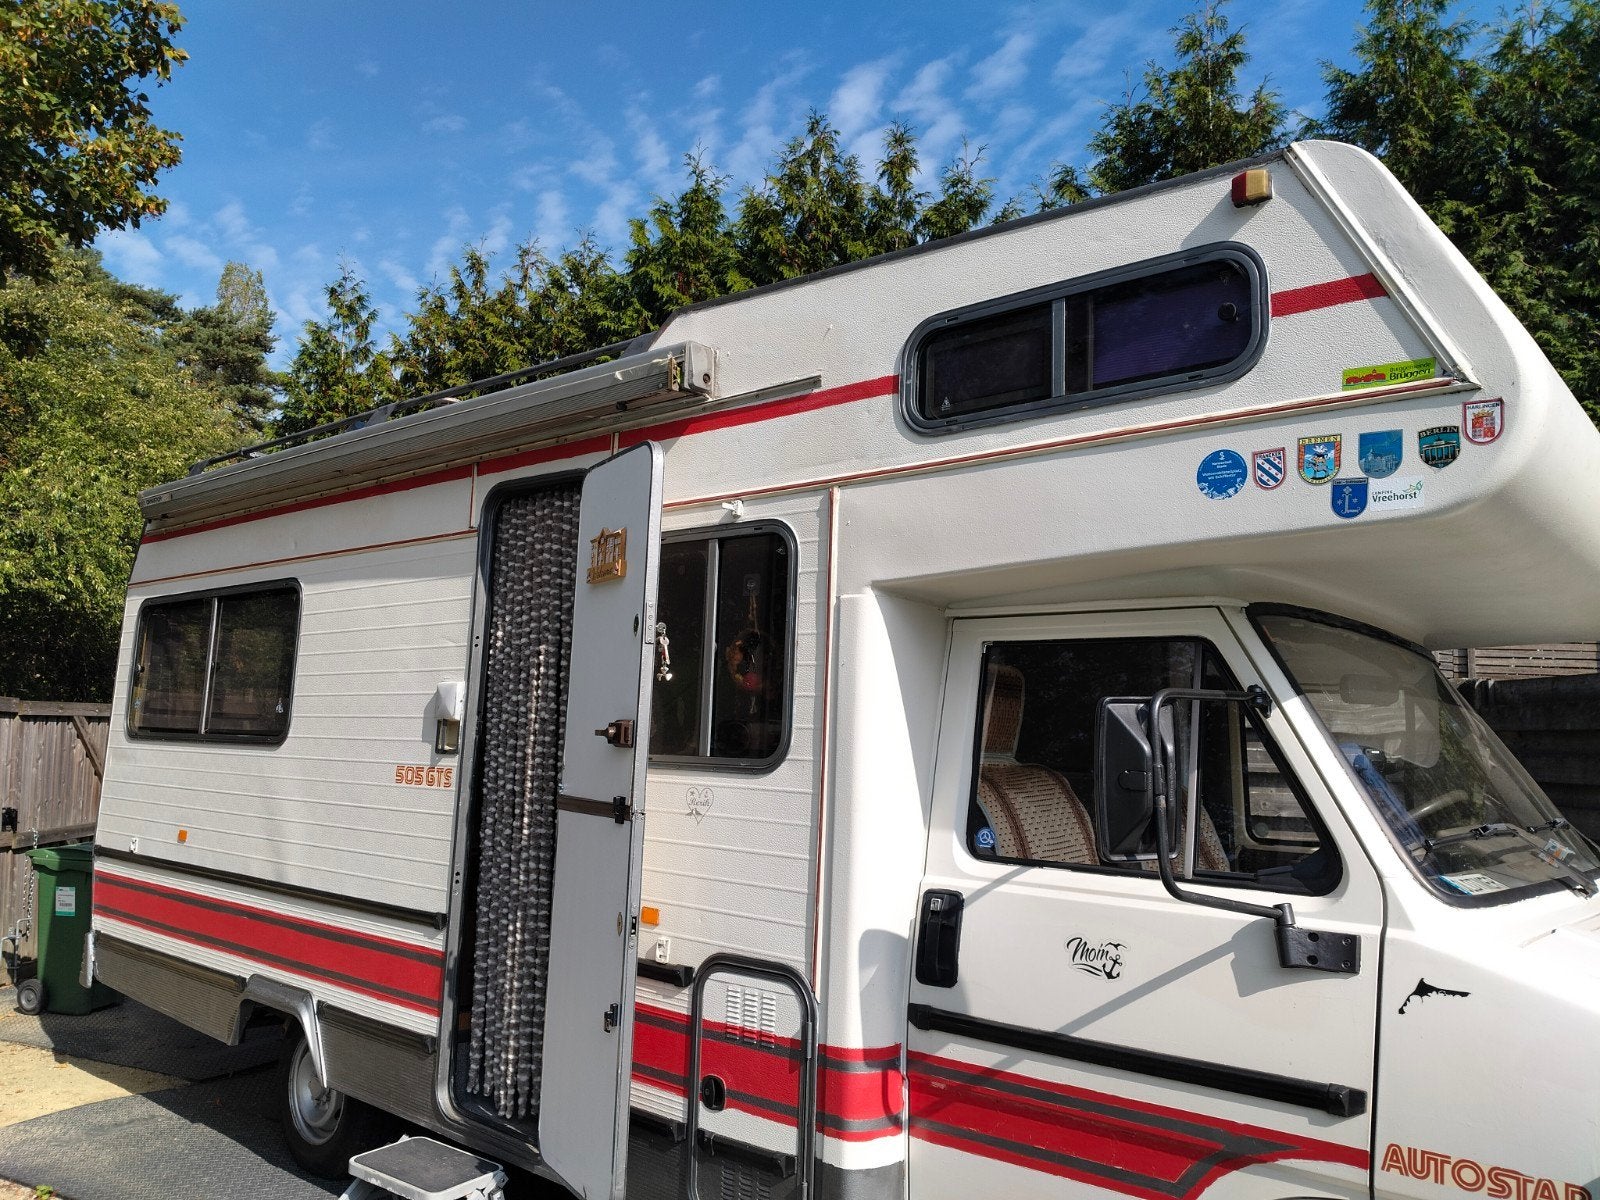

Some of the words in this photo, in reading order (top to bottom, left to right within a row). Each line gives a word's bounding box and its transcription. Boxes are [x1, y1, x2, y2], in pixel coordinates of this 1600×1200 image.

[1390, 367, 1431, 381] Brüggen
[1420, 426, 1458, 438] BERLIN
[1302, 436, 1338, 445] BREMEN
[1372, 491, 1418, 503] Vreehorst
[395, 765, 424, 786] 505
[425, 766, 453, 788] GTS
[1066, 937, 1109, 963] Moin
